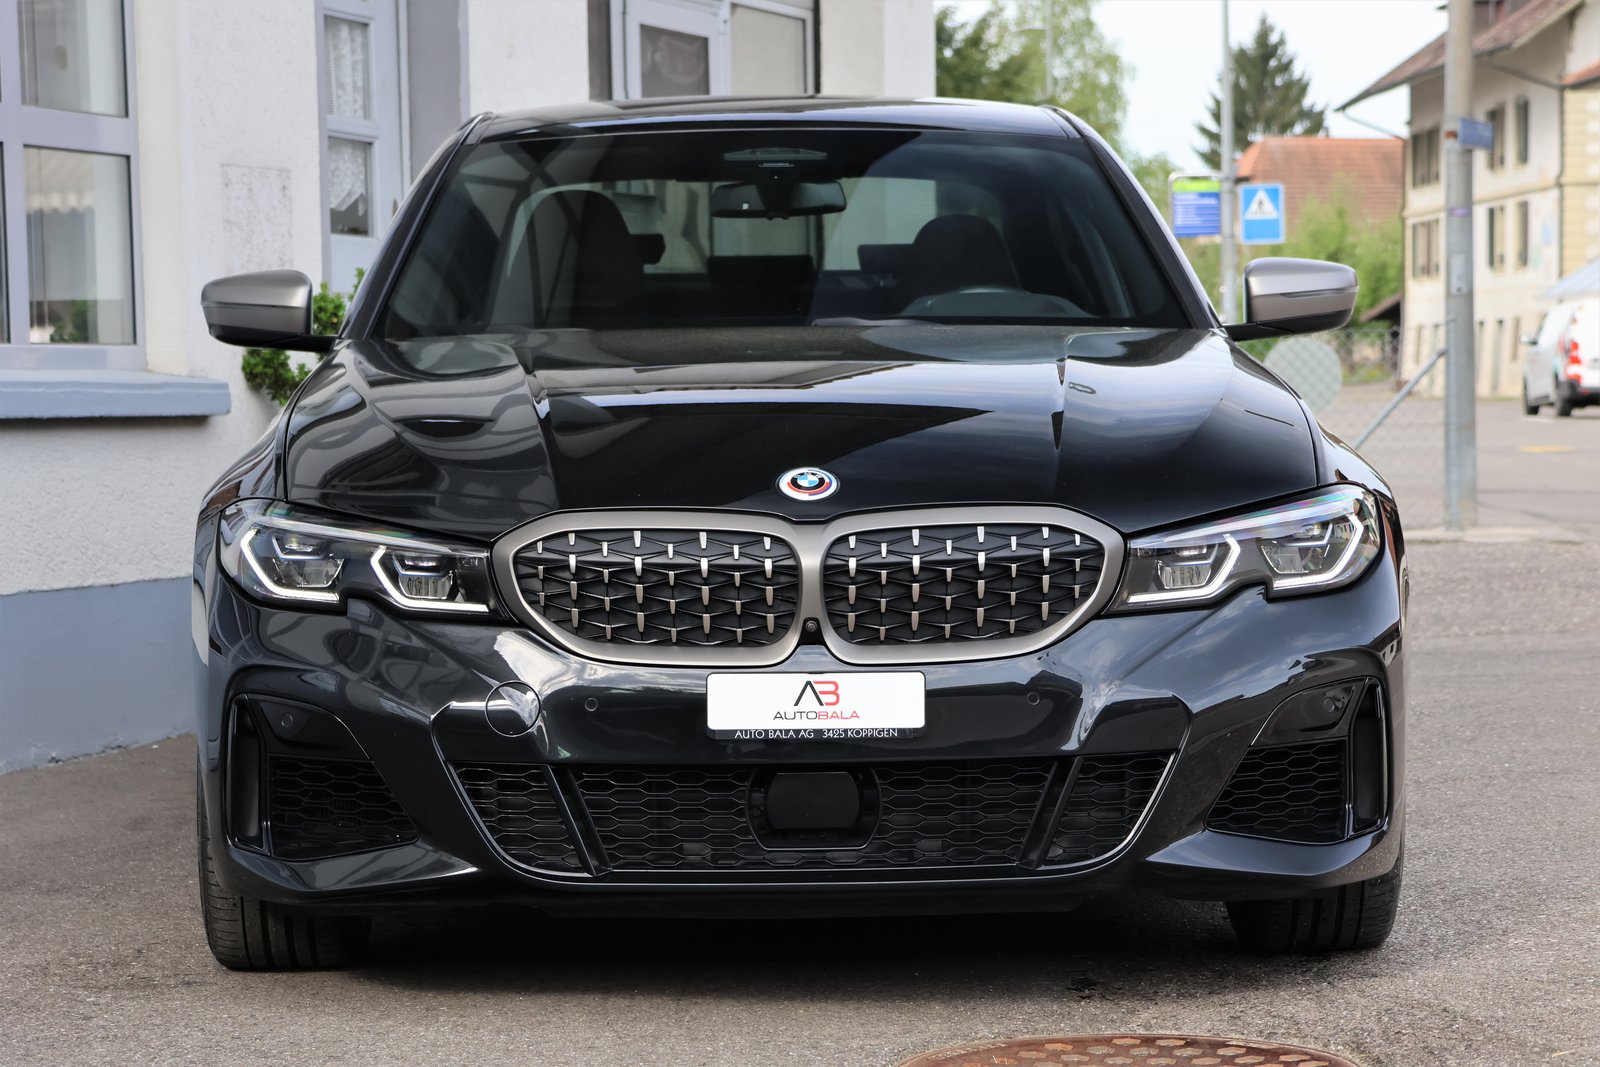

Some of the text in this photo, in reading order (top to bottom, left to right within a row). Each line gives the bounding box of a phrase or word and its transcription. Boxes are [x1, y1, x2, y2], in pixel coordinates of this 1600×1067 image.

[734, 728, 898, 739] AUTO BALA AG 3425 KOPPIGEN
